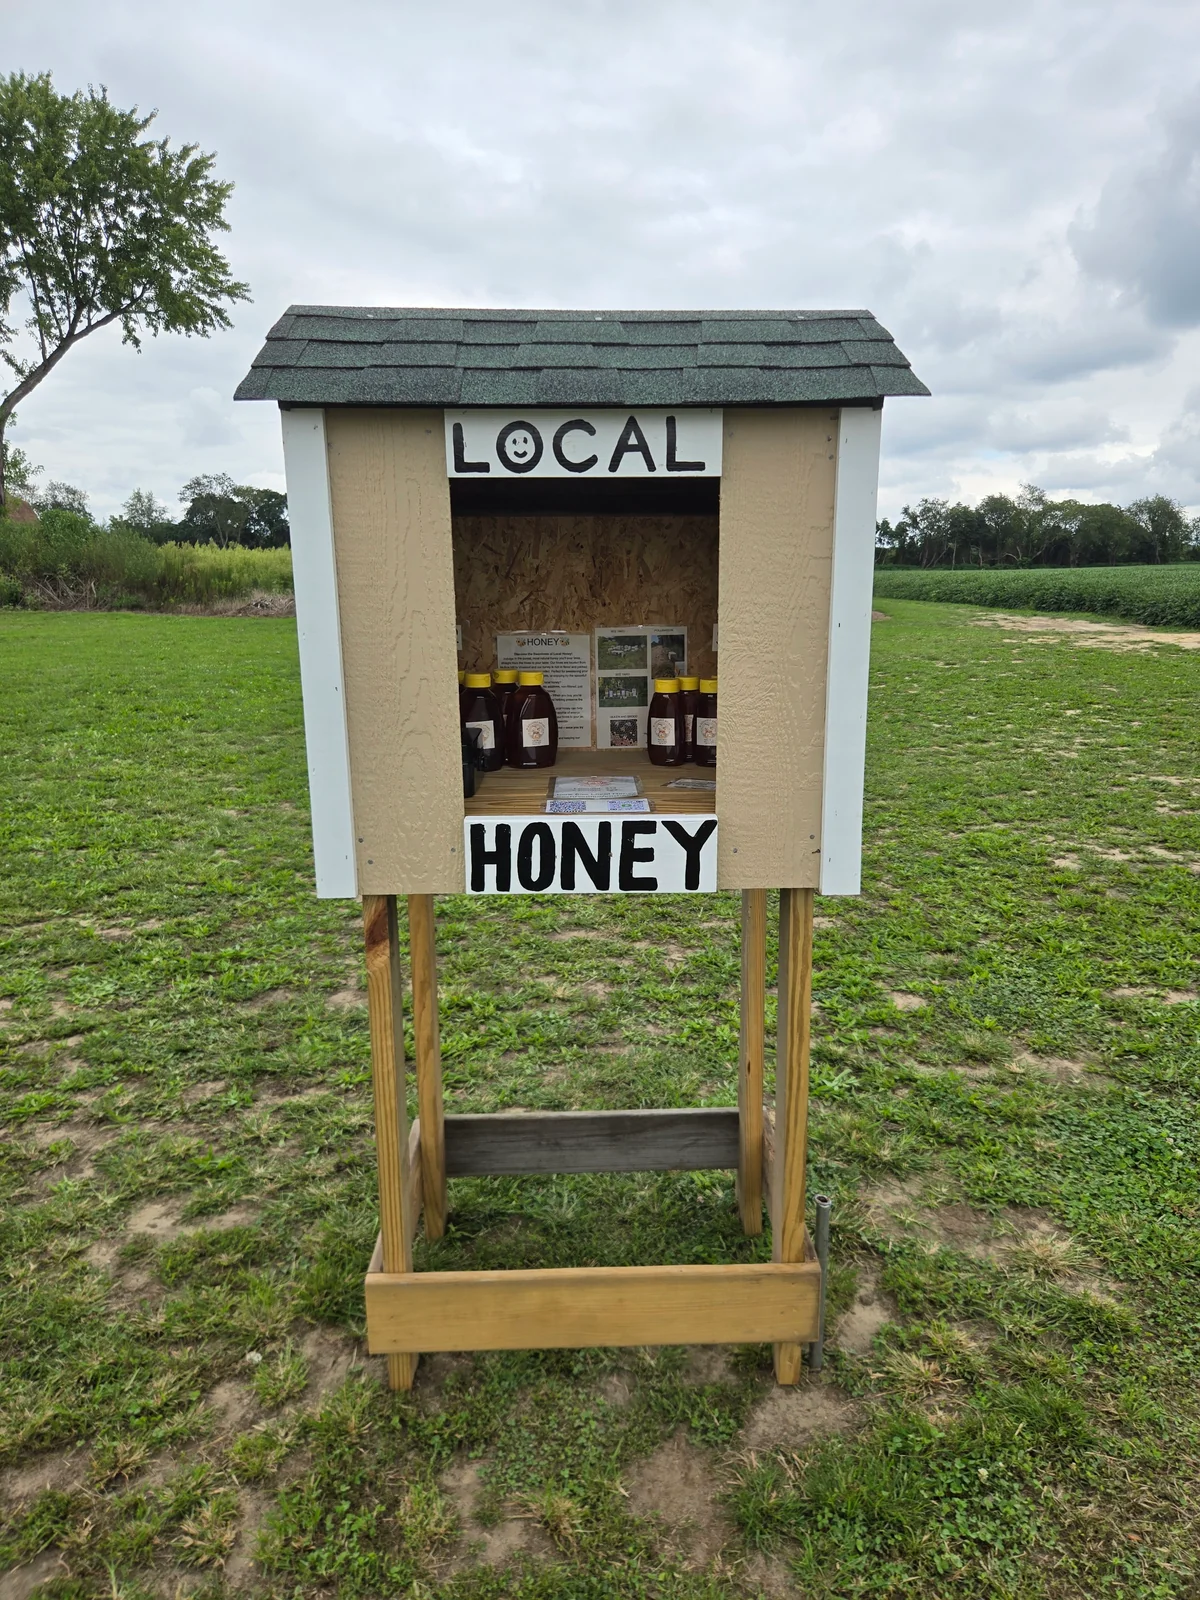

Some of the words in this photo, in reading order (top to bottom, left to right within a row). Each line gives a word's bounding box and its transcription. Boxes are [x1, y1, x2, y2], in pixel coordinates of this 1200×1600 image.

[453, 415, 705, 473] LOCAL
[527, 638, 559, 646] HONEY
[470, 820, 717, 892] HONEY
